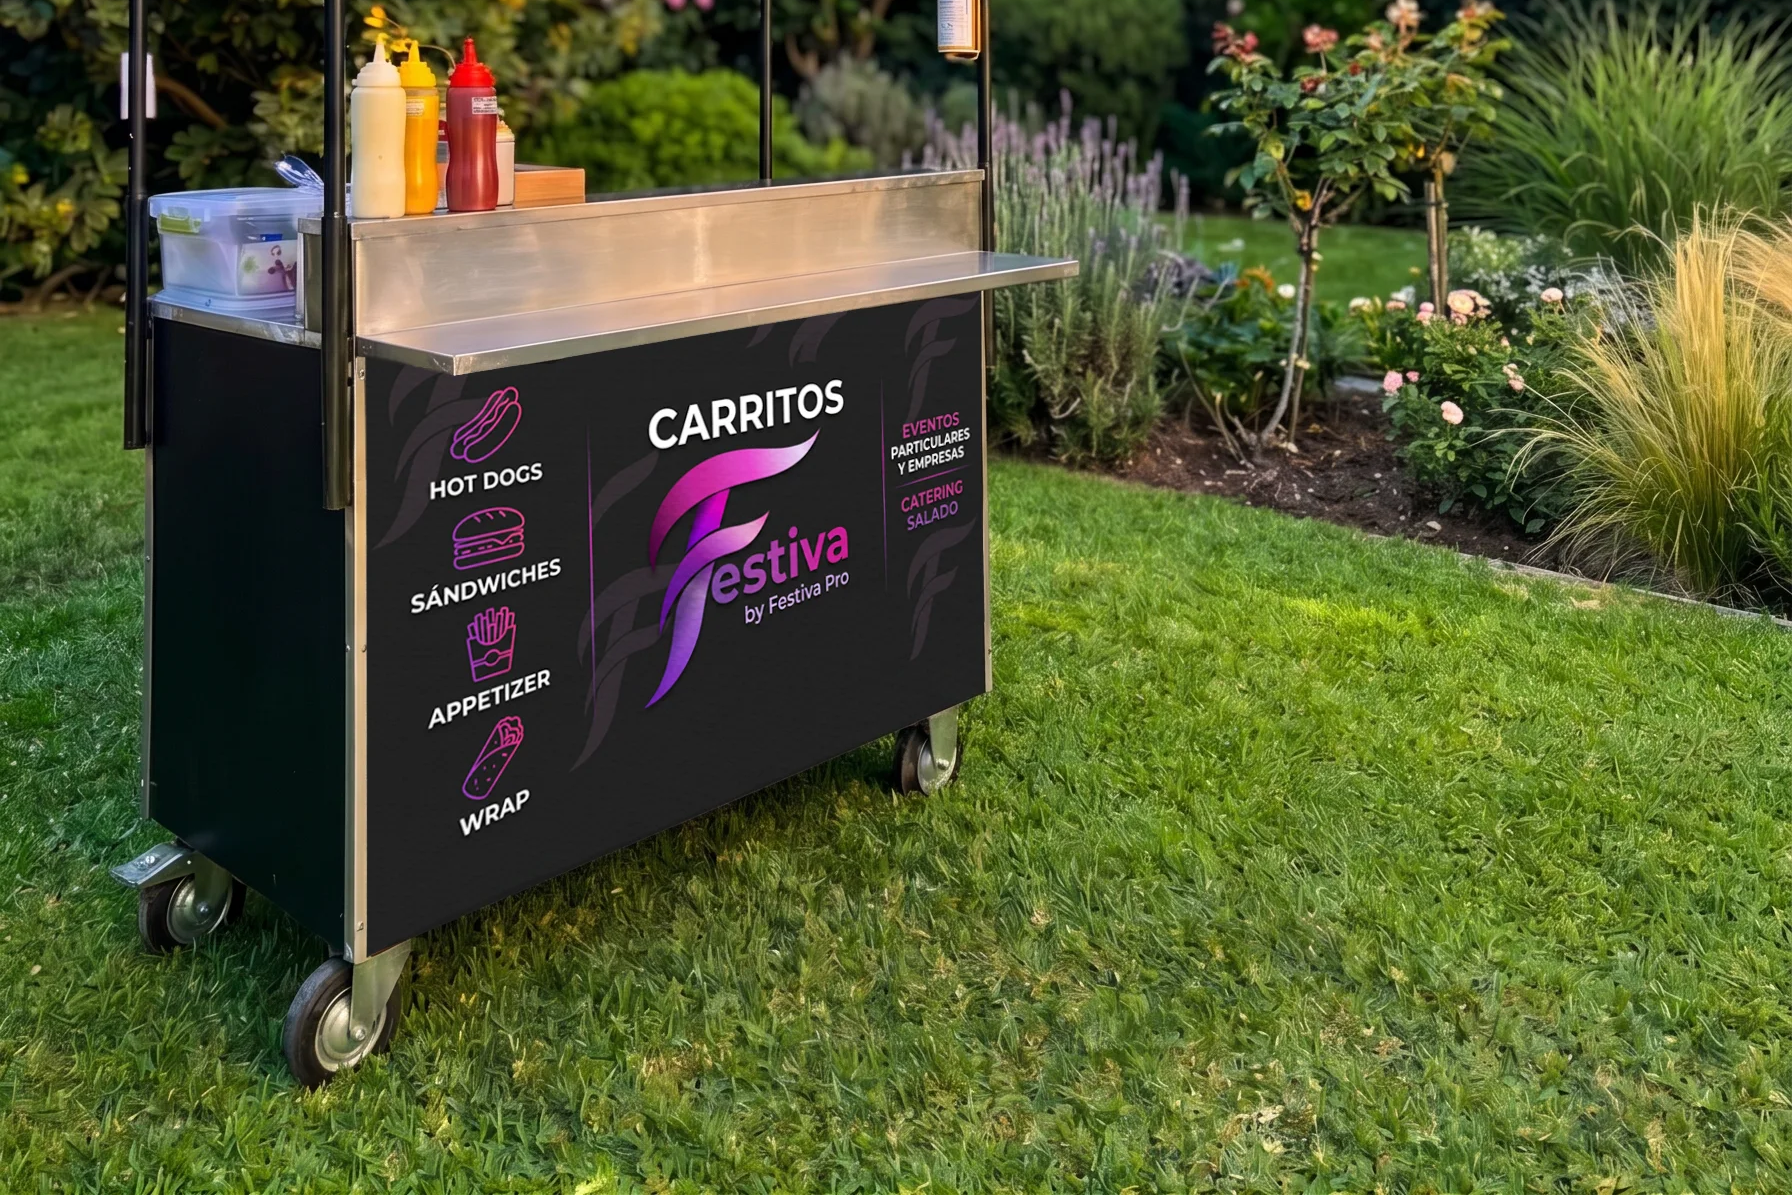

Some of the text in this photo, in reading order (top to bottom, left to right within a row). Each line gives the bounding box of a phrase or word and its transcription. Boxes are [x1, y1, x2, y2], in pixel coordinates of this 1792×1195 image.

[648, 379, 844, 450] CARRITOS
[902, 412, 960, 439] EVENTOS
[891, 427, 970, 460] PARTICULARES
[897, 445, 965, 475] Y EMPRESAS
[429, 463, 543, 499] HOT DOGS
[901, 480, 963, 512] CATERING
[907, 501, 959, 531] SALADO
[410, 558, 562, 614] SÁNDWICHES
[645, 427, 849, 709] Festiva
[745, 571, 850, 625] by Festiva Pro
[428, 669, 551, 729] APPETIZER
[459, 789, 531, 837] WRAP
